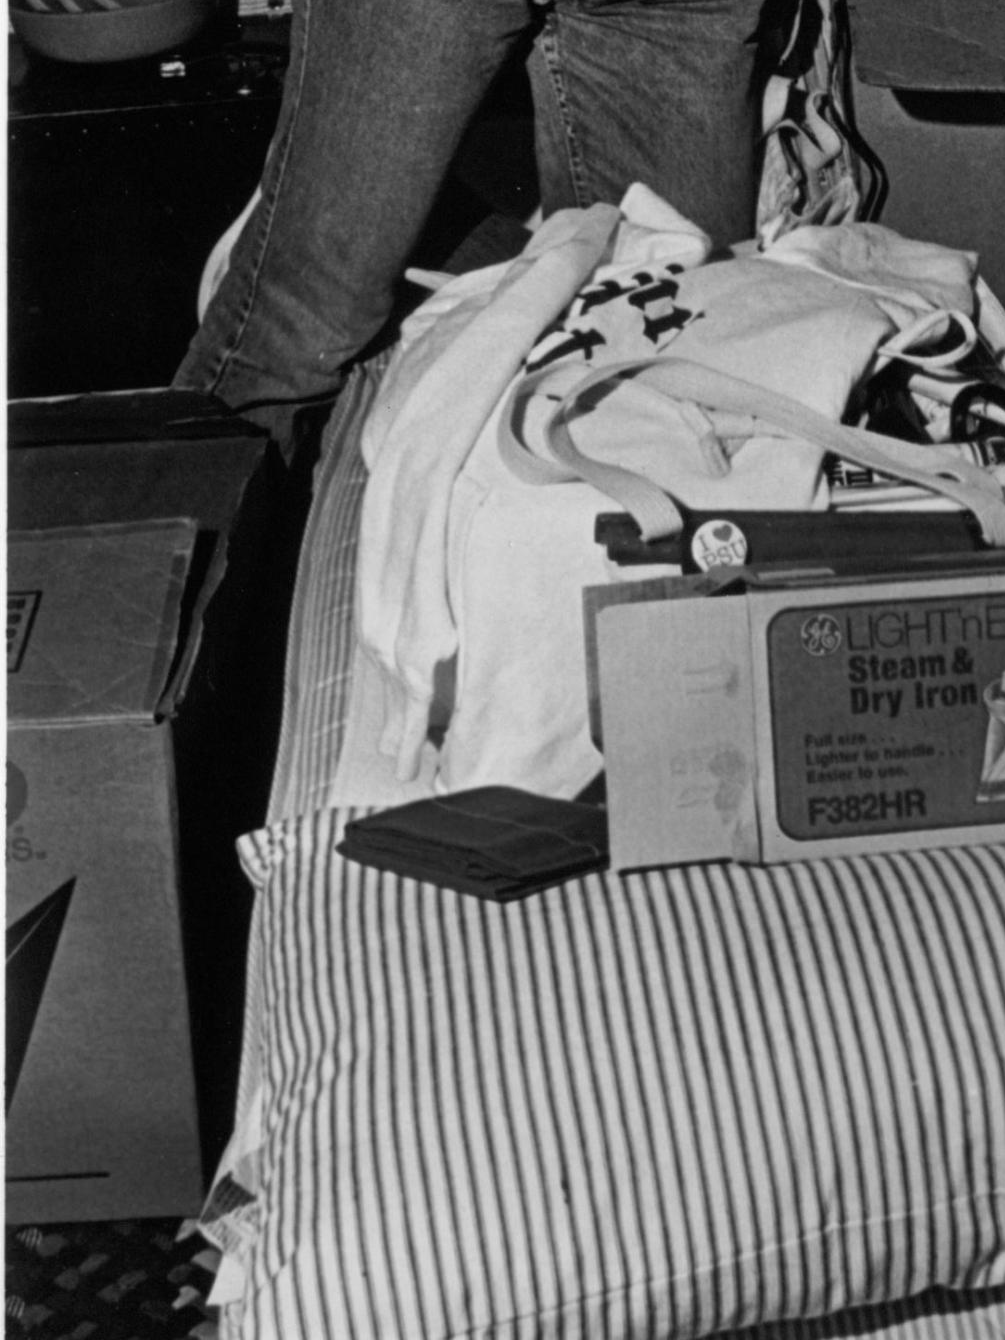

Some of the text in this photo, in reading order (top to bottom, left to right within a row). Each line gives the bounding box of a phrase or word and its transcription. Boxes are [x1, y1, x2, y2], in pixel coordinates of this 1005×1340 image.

[849, 647, 973, 683] Steam &
[850, 681, 978, 717] Dry Iron
[805, 733, 832, 748] Full
[806, 750, 859, 768] Lighter
[864, 748, 879, 762] to
[884, 744, 935, 760] handle
[807, 769, 853, 784] Easier
[858, 767, 873, 780] to
[807, 789, 927, 826] F382HR
